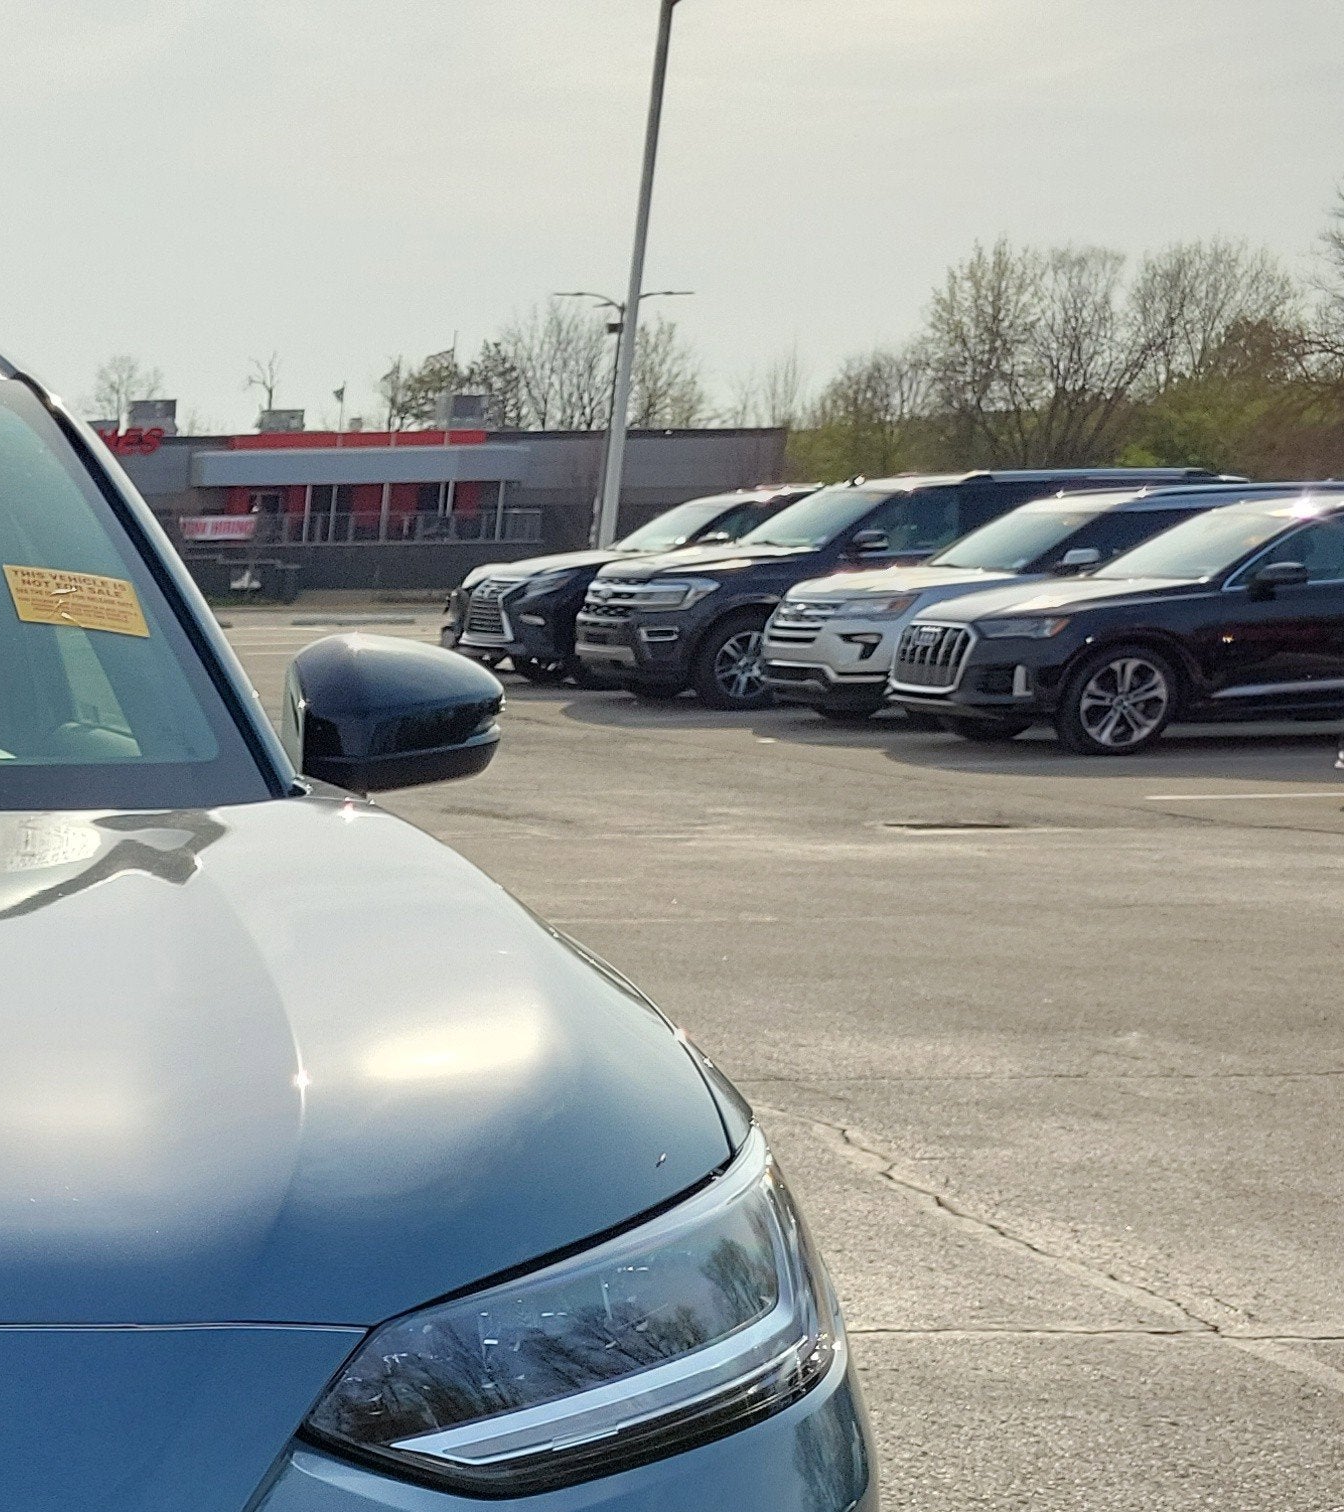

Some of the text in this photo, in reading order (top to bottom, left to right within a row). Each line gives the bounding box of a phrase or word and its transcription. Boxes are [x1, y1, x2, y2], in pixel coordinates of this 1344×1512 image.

[12, 570, 127, 591] THIS VEHICLE IS
[21, 579, 123, 597] NOT FOR SALE
